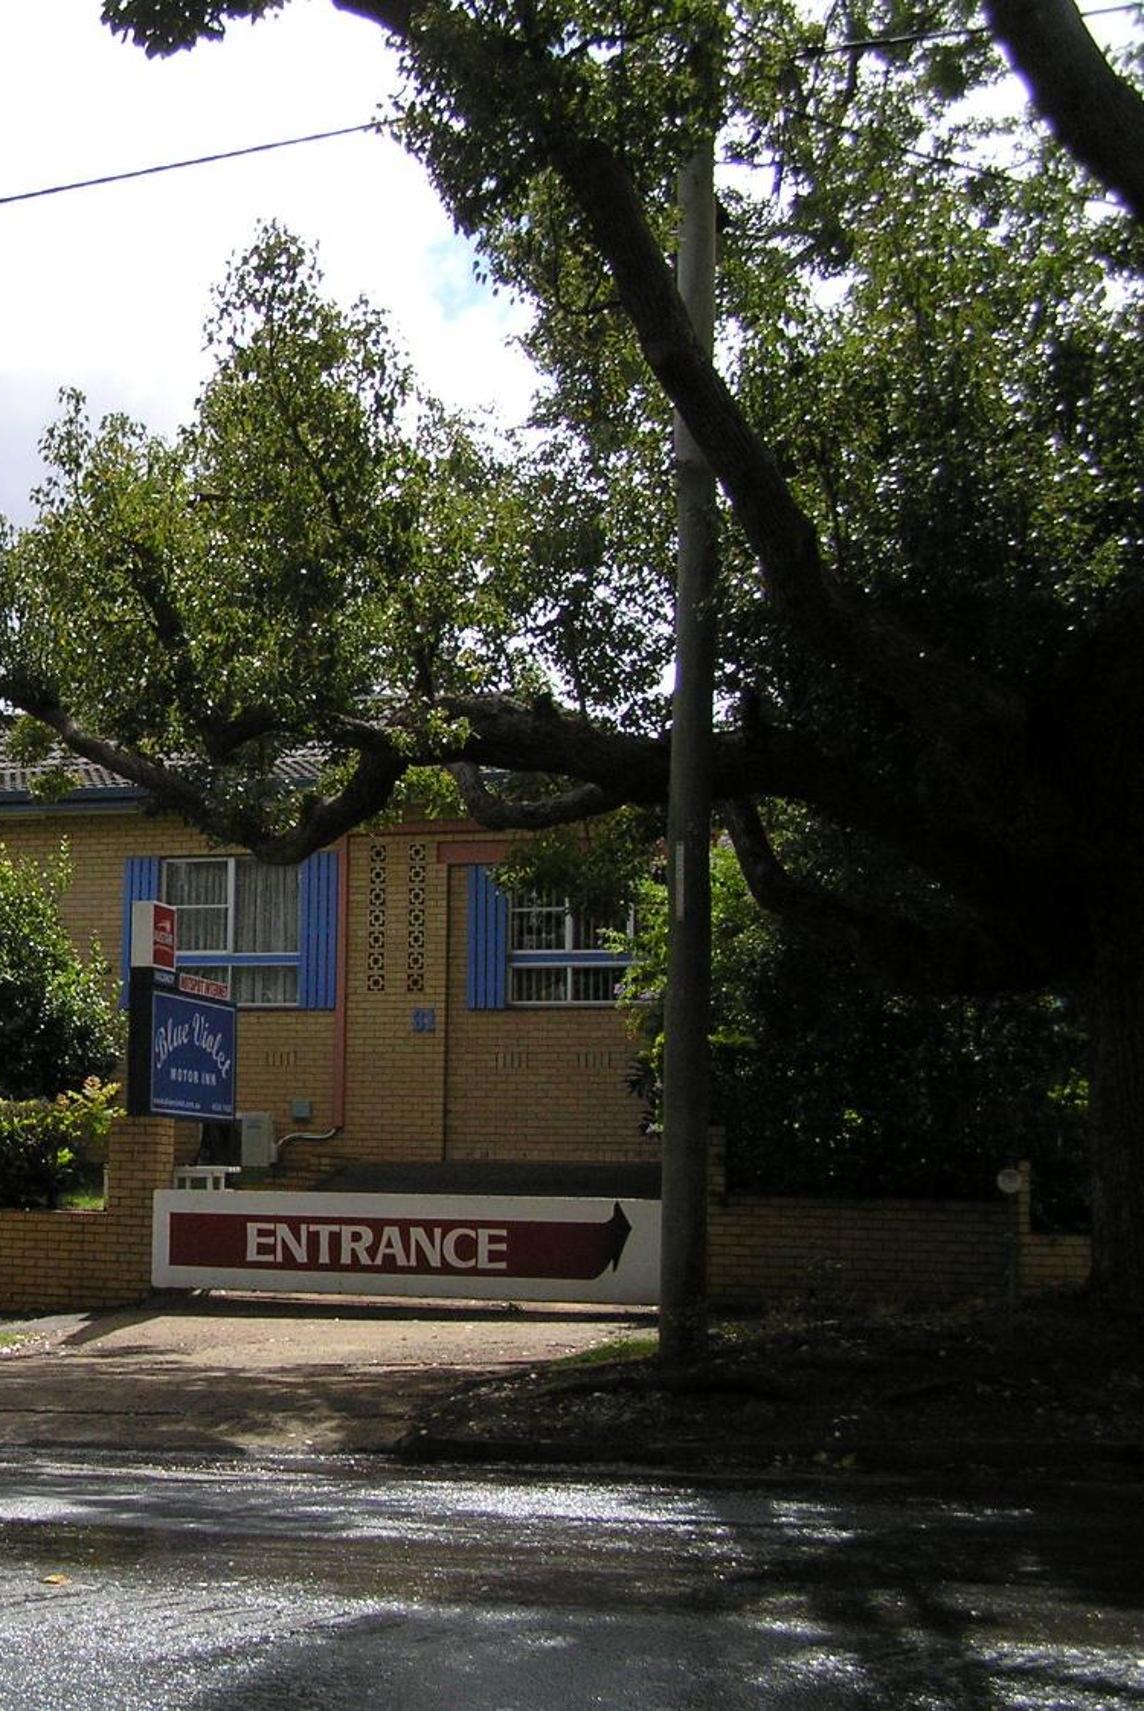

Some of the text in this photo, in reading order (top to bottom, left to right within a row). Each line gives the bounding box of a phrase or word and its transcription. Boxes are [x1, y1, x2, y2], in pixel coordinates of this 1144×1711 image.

[155, 1017, 190, 1070] Blue
[170, 1067, 217, 1086] MOTOR INN
[246, 1221, 508, 1270] ENTRANCE
